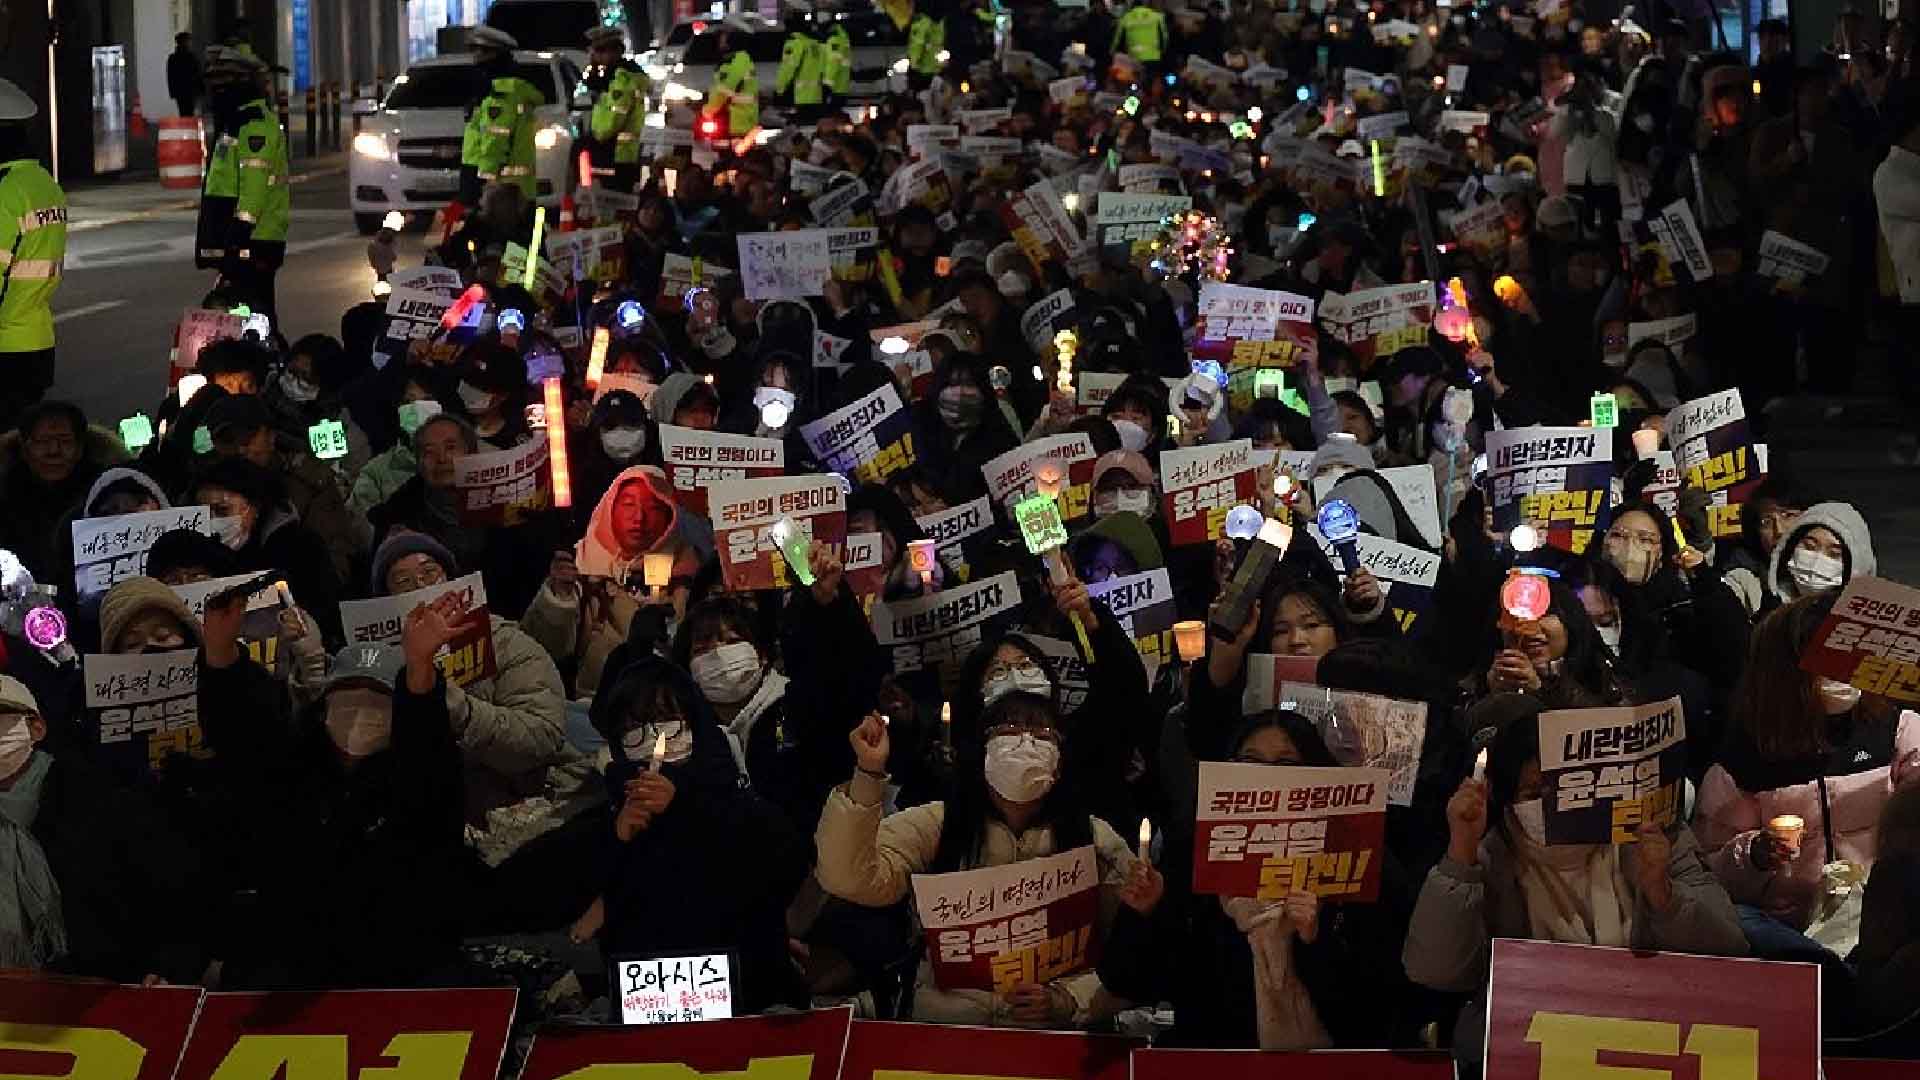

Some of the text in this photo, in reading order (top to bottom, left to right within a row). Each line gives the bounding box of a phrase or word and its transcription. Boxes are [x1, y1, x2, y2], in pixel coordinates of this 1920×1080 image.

[36, 207, 68, 225] POLI
[671, 445, 777, 463] 국민의 명령이다
[1496, 433, 1596, 476] 내란범죄자
[722, 485, 838, 523] 국민의 명령이다
[892, 581, 1005, 640] 내란범죄자
[1847, 595, 1904, 624] 국민의
[1562, 706, 1676, 763] 내란범죄자
[1210, 782, 1375, 813] 국민의 명령이다
[1556, 752, 1661, 813] 윤석열
[1207, 819, 1328, 862] 윤석열
[931, 860, 1086, 922] 국민의 명령이다
[1256, 848, 1374, 904] 퇴진!
[937, 908, 1049, 964] 윤석열
[626, 957, 727, 995] 오아시스
